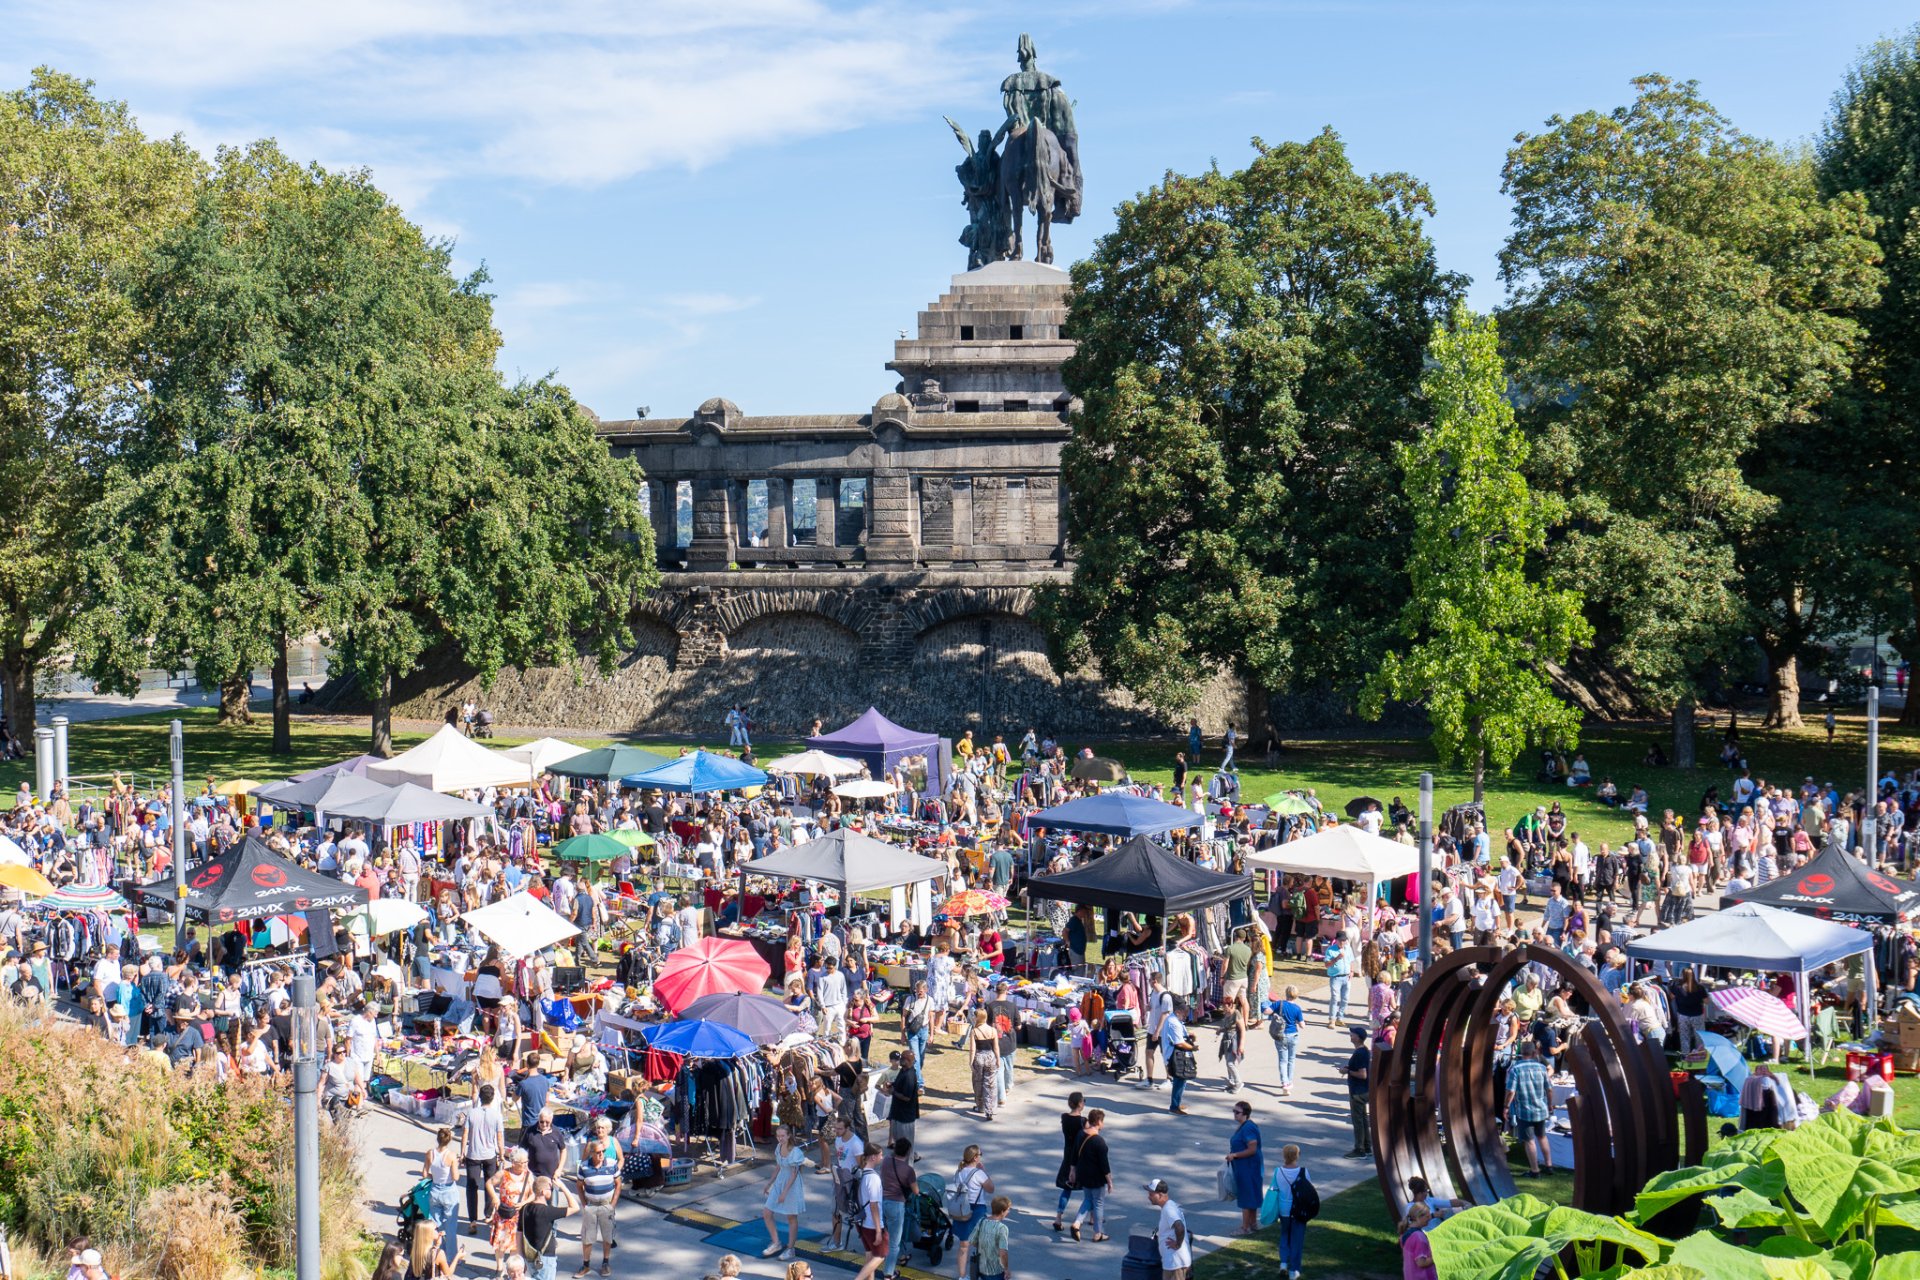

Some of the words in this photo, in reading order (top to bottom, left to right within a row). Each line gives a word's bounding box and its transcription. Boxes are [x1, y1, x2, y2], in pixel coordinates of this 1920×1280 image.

[255, 885, 305, 898] 24MX
[143, 894, 167, 908] 24MX
[311, 894, 356, 907] 24MX
[1779, 894, 1835, 904] 24MX
[237, 902, 284, 918] 24MX
[1831, 912, 1883, 924] 24MX
